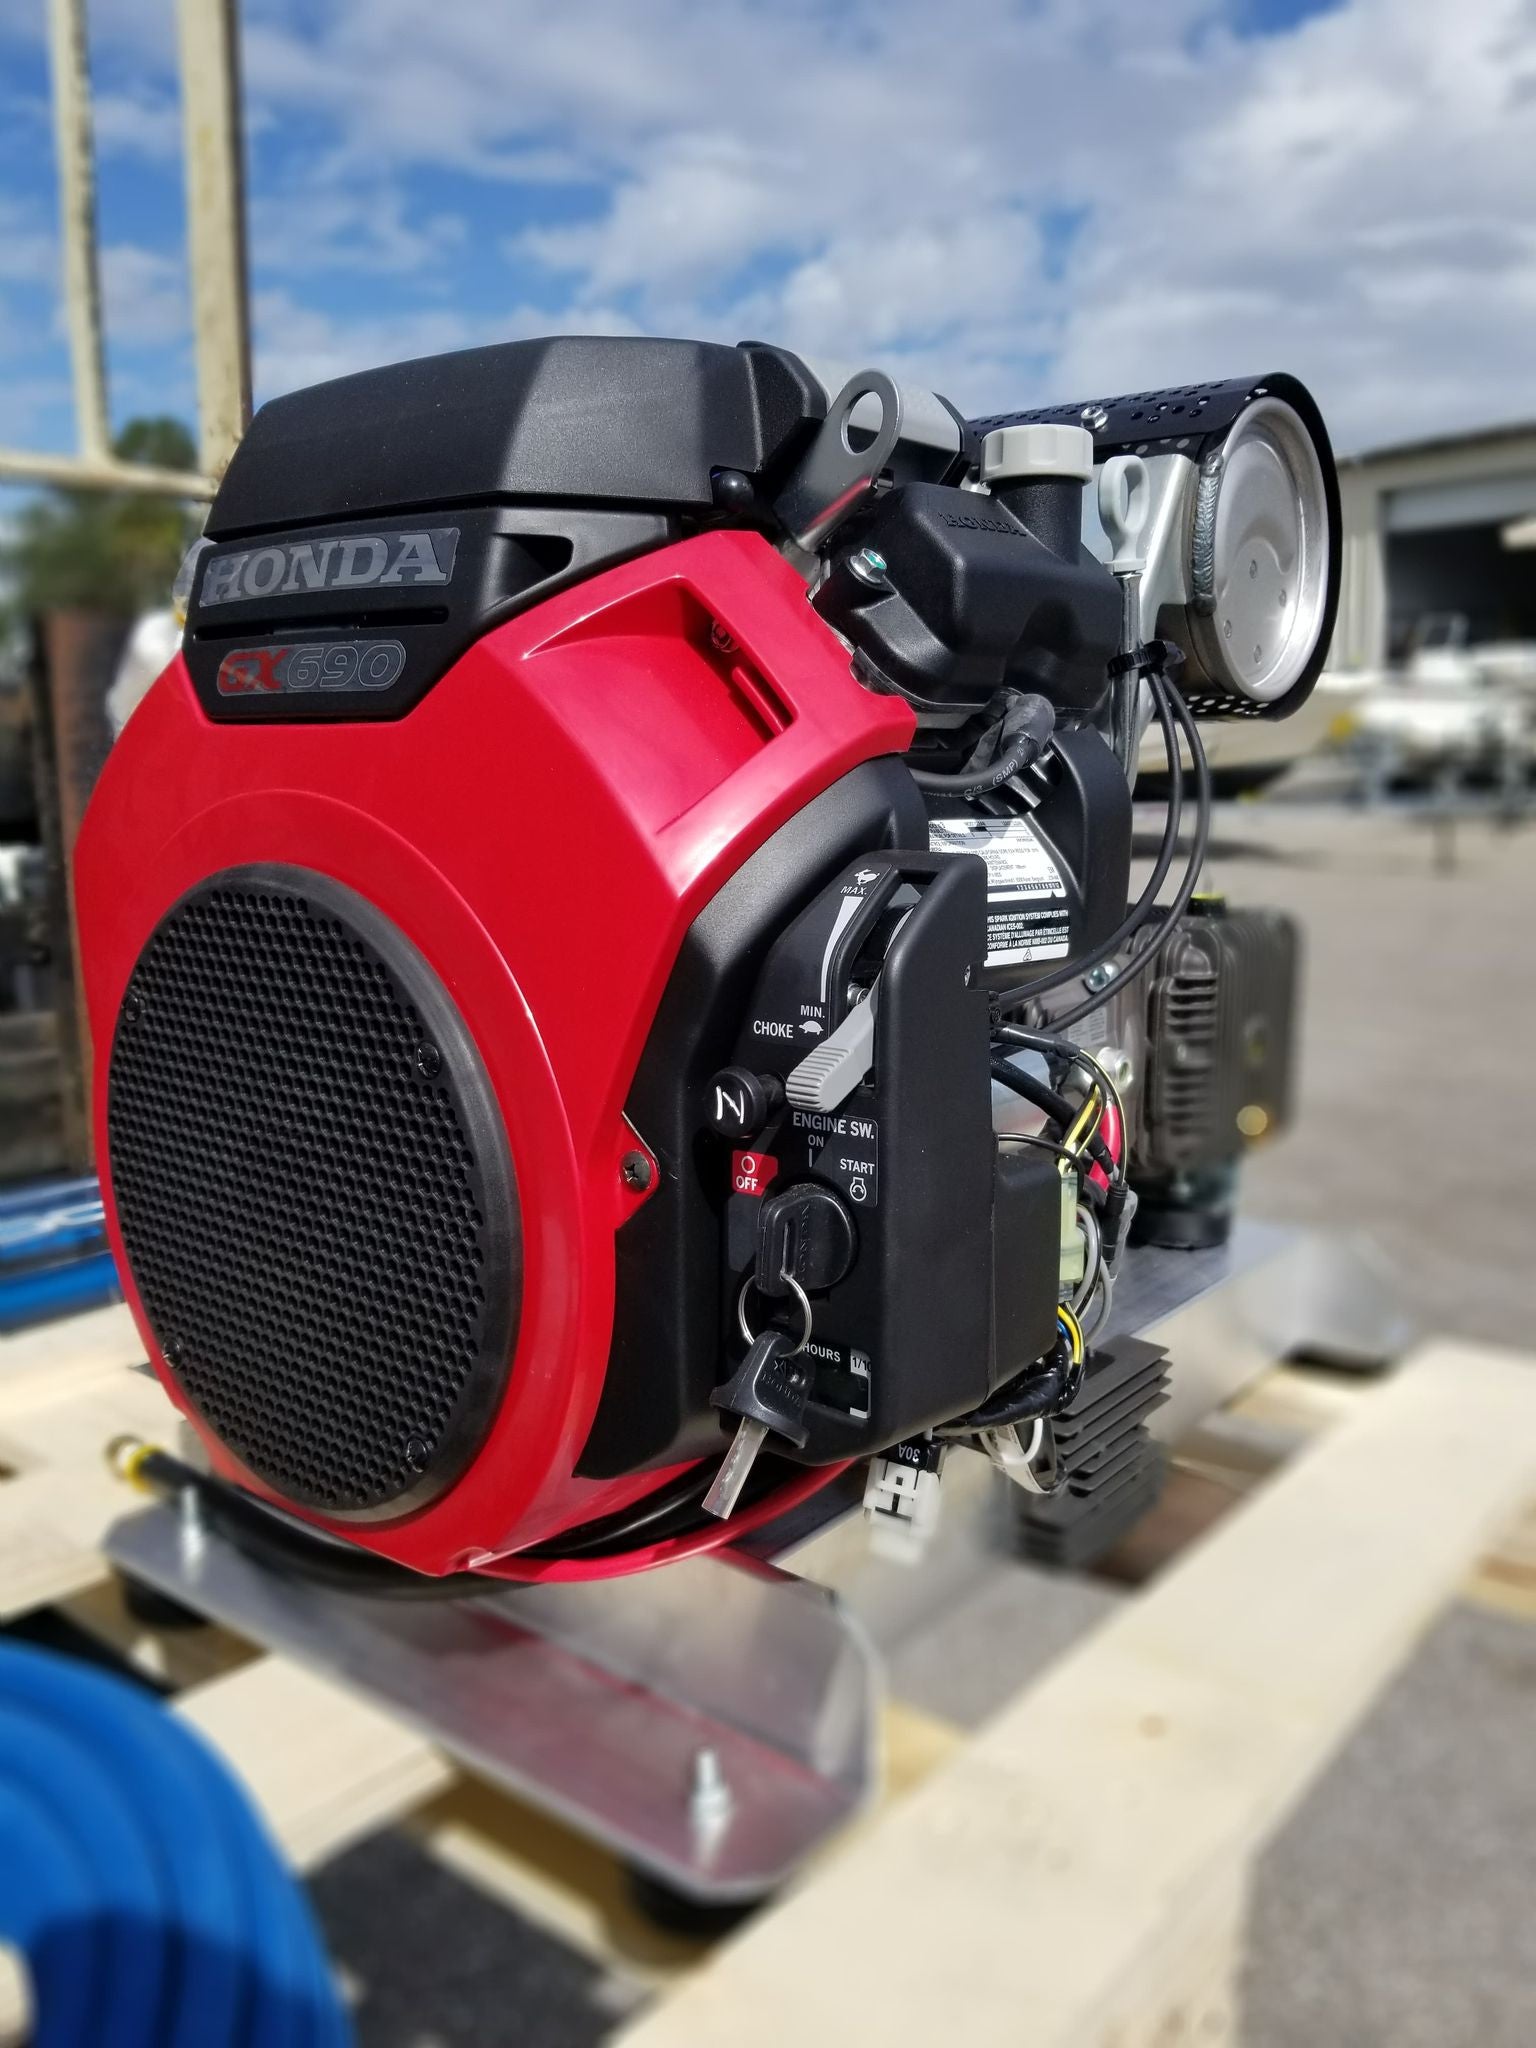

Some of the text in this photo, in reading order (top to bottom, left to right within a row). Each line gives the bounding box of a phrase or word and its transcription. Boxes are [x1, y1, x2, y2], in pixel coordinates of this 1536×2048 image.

[207, 533, 448, 600] HONDA
[217, 644, 405, 693] GX690
[992, 758, 1019, 785] (SMP)
[840, 885, 867, 895] MAX.
[994, 914, 1008, 923] SPARK
[1008, 912, 1026, 921] IGNITION
[1026, 911, 1041, 920] SYSTEM
[1041, 910, 1059, 919] COMPLIES
[1035, 928, 1043, 937] PAR
[1062, 926, 1070, 934] EST
[1018, 938, 1032, 947] NORME
[800, 1004, 826, 1018] MIN.
[753, 1020, 794, 1039] CHOKE
[793, 1111, 875, 1140] ENGINE SW.
[807, 1134, 824, 1148] ON
[840, 1157, 875, 1175] START
[736, 1175, 759, 1191] OFF
[801, 1342, 841, 1363] HOURS
[898, 1443, 921, 1463] 30A
